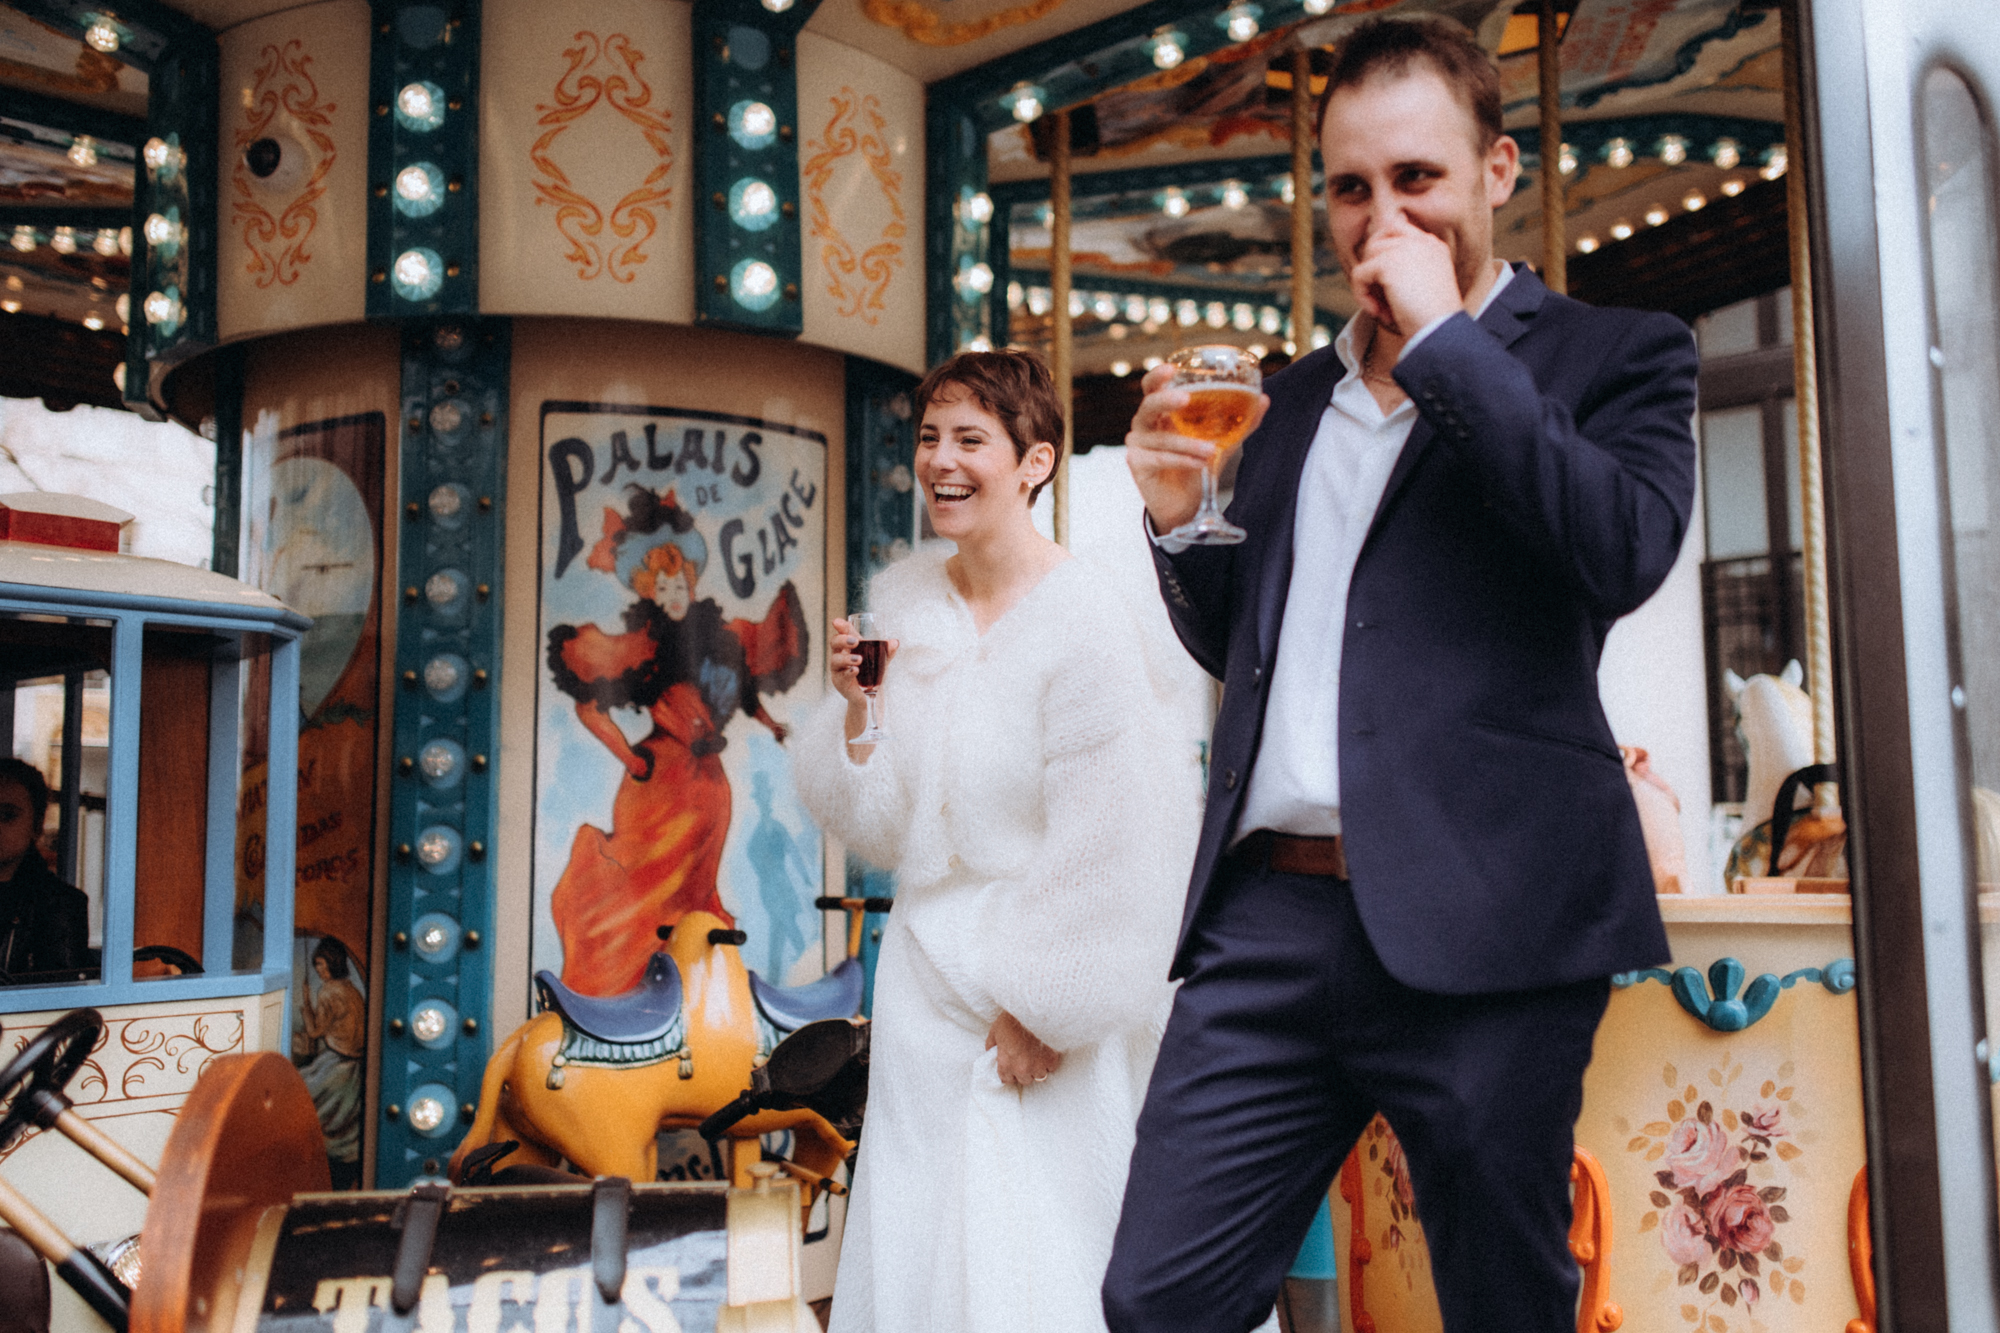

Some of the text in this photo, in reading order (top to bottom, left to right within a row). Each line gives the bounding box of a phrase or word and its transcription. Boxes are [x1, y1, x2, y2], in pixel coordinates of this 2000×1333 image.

[549, 424, 763, 580] PALAIS
[695, 483, 722, 507] DE
[719, 468, 816, 599] GLACE
